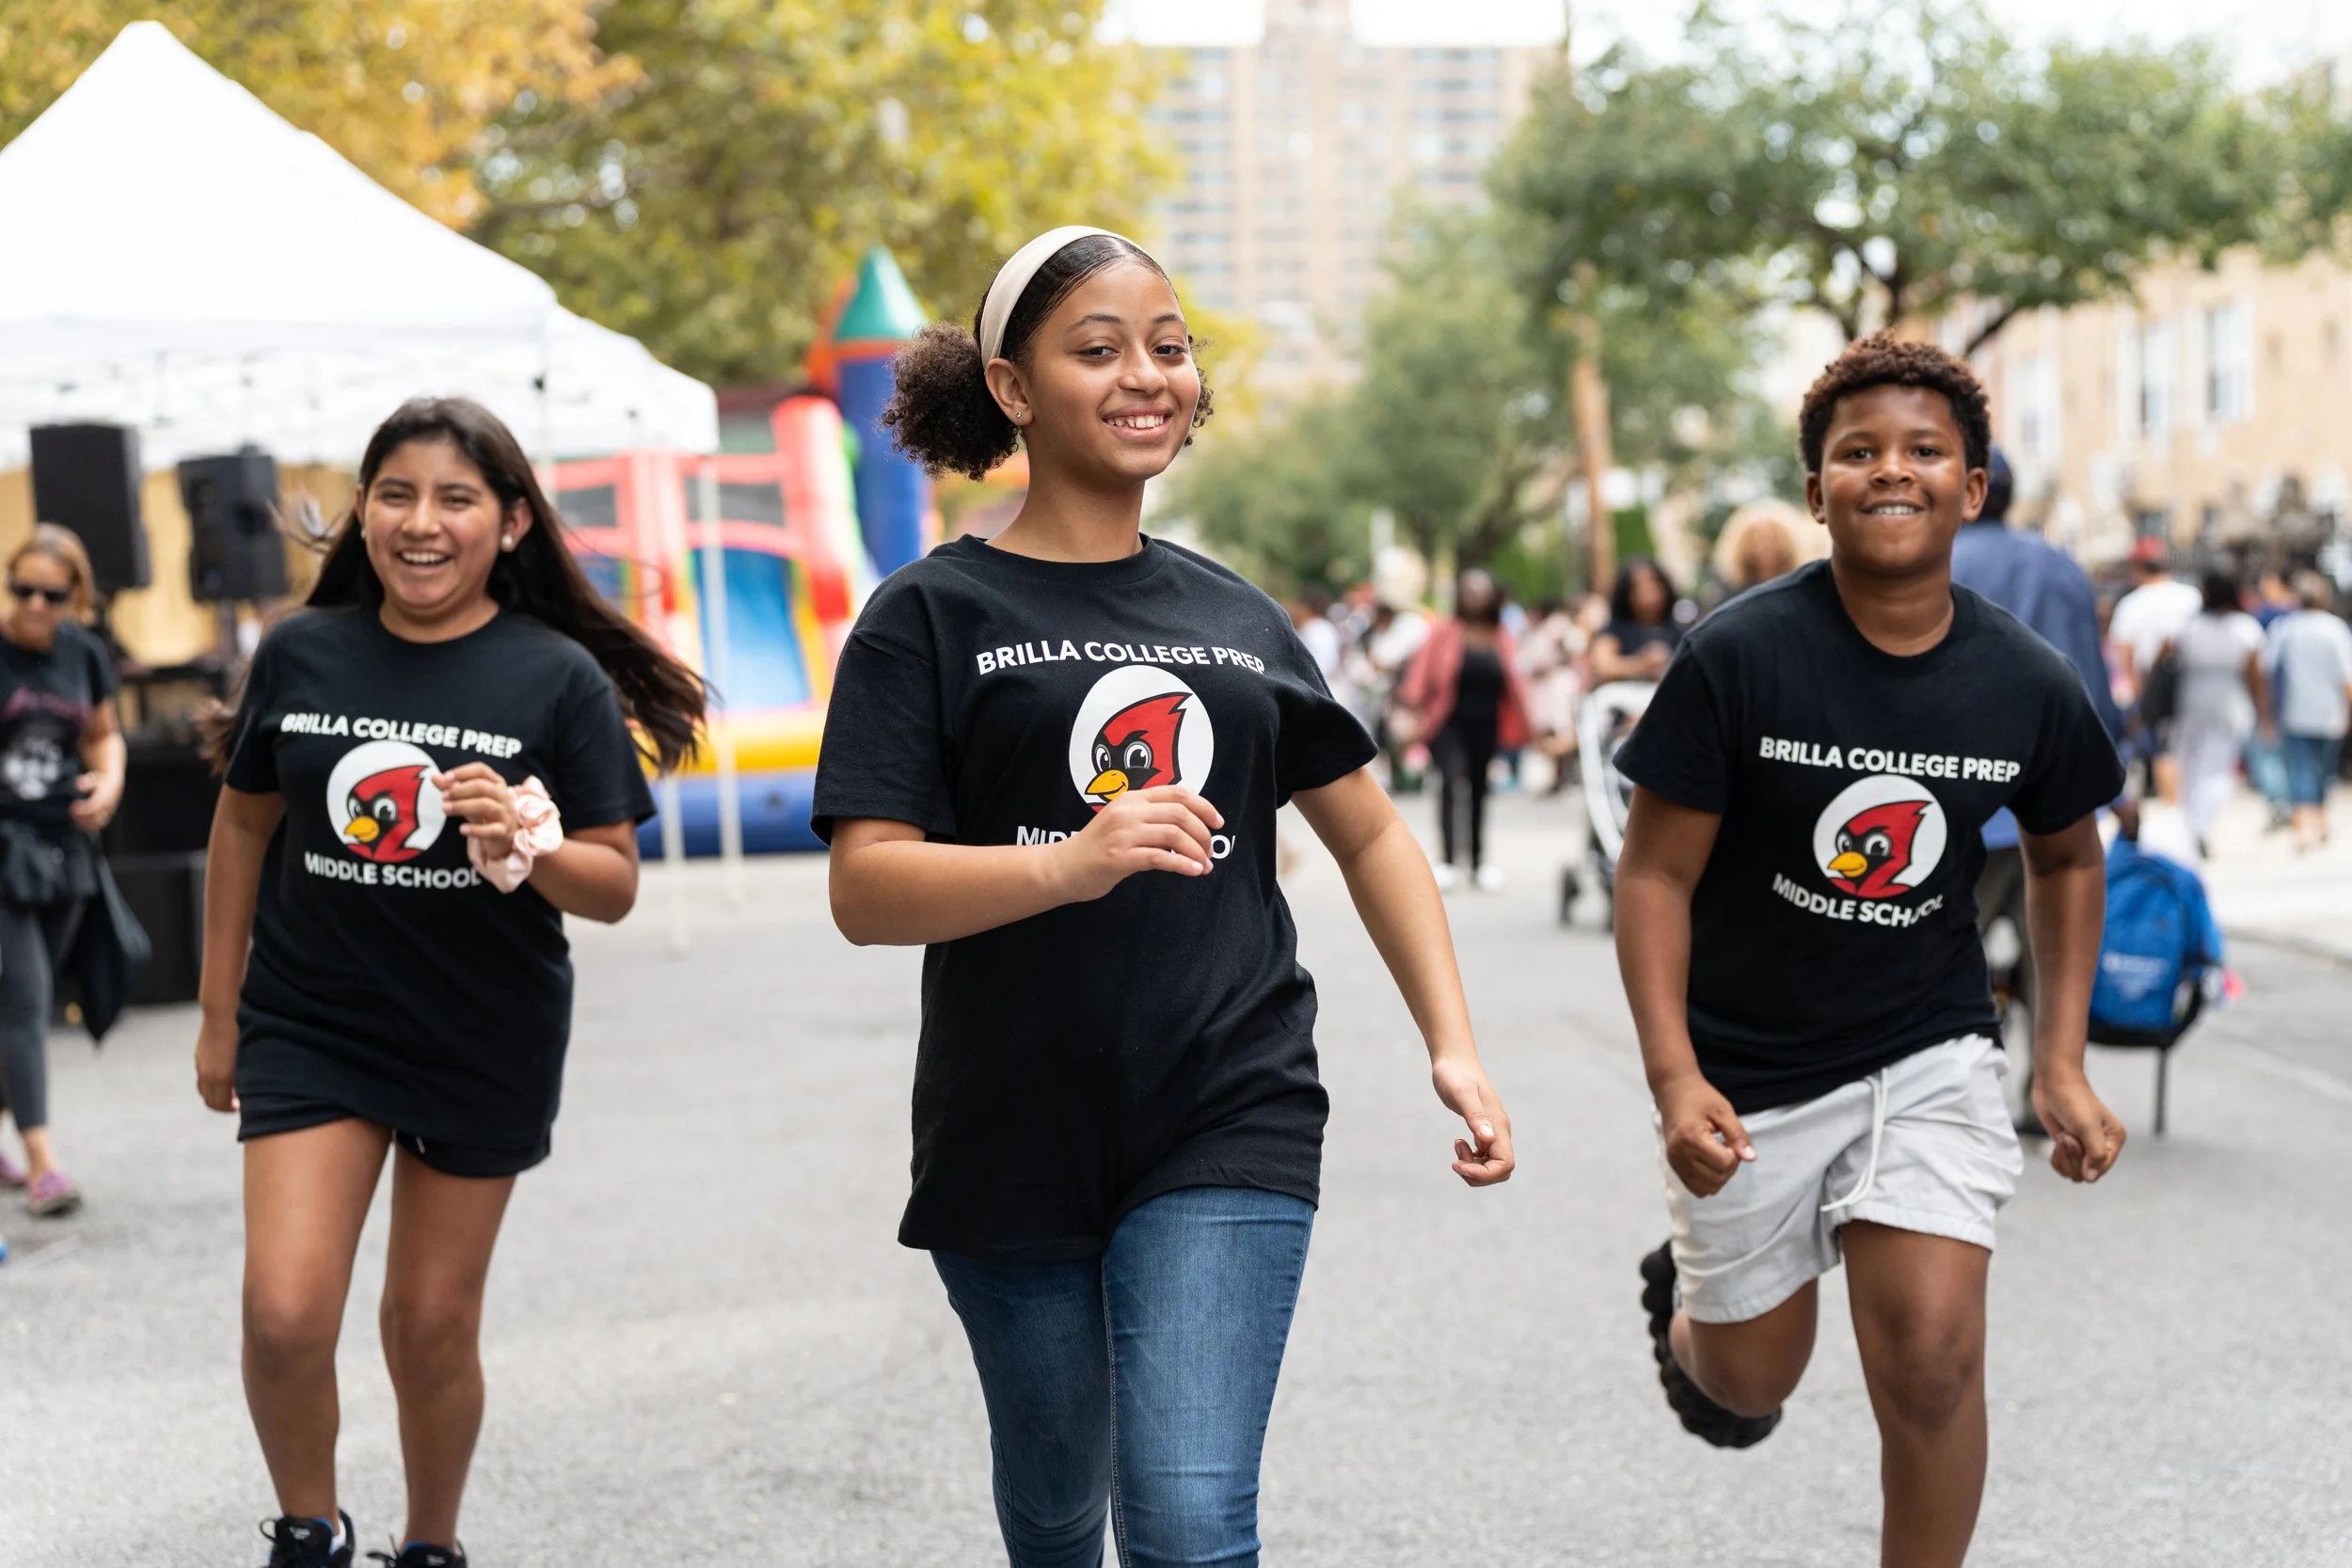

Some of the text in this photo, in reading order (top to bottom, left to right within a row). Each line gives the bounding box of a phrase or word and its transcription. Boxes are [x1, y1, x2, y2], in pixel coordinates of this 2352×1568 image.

[976, 640, 1265, 675] BRILLA COLLEGE PREP
[281, 713, 522, 758] BRILLA COLLEGE PREP
[1758, 736, 2021, 783] BRILLA COLLEGE PREP
[305, 852, 482, 889] MIDDLE SCHOOL
[1772, 873, 1856, 921] MIDDLE
